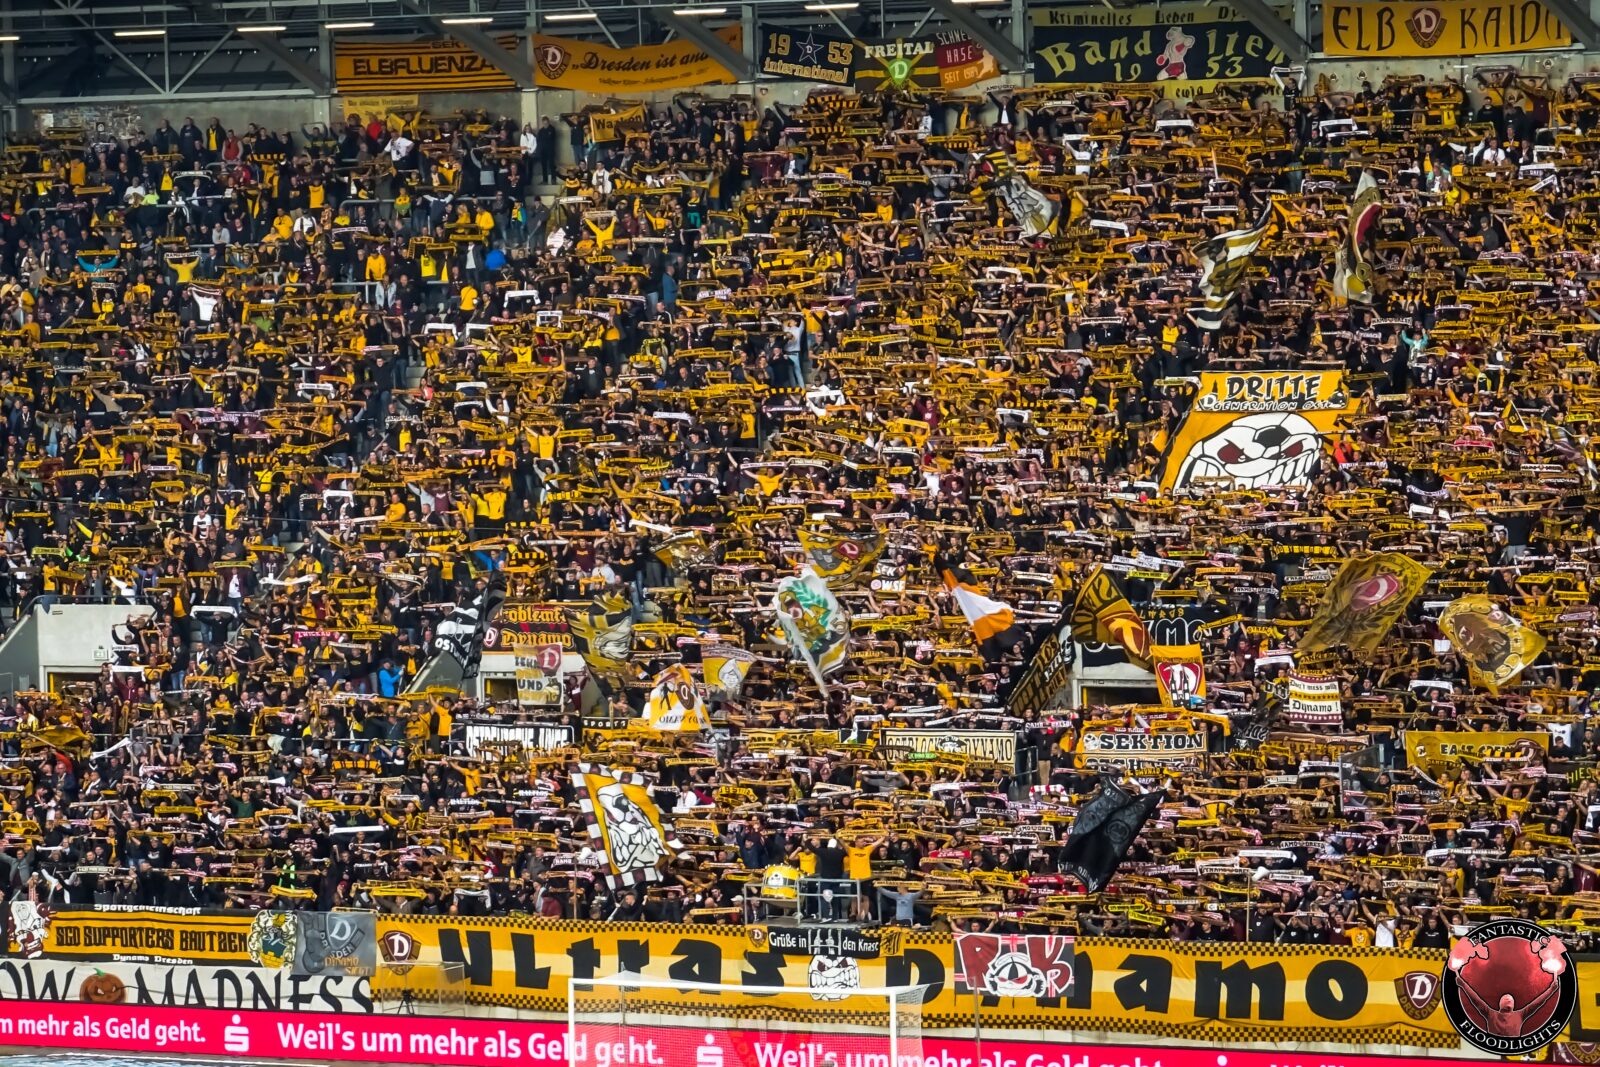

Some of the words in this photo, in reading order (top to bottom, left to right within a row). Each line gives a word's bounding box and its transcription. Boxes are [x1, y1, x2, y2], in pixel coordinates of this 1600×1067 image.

[1048, 9, 1132, 25] Kriminelles
[1332, 6, 1396, 51] ELB
[768, 33, 791, 55] 19
[827, 41, 854, 65] 53
[864, 41, 934, 59] FREITAL
[946, 45, 973, 63] HASE
[1035, 30, 1152, 78] Band
[655, 53, 678, 68] ist
[763, 57, 849, 83] international
[1113, 62, 1142, 82] 19
[1205, 53, 1243, 78] 53
[944, 70, 961, 84] SEIT
[1226, 374, 1322, 400] DRITTE
[517, 678, 543, 691] UND
[1291, 699, 1333, 713] Dynamo
[1098, 732, 1206, 751] SEKTION
[55, 925, 81, 946] SGD
[83, 926, 174, 950] SUPPORTERS
[179, 929, 248, 952] BAUTZEN
[768, 931, 797, 949] Grüße
[798, 934, 807, 948] in
[842, 937, 856, 951] den
[112, 952, 150, 963] Dynamo
[153, 955, 194, 965] Dresden
[18, 1015, 70, 1038] mehr
[73, 1015, 102, 1038] als
[106, 1018, 151, 1041] Geld
[155, 1022, 206, 1046] geht.
[277, 1021, 356, 1051] Weil's
[362, 1032, 402, 1053] um
[409, 1028, 479, 1056] mehr
[483, 1030, 522, 1058] als
[528, 1032, 589, 1062] Geld
[594, 1034, 664, 1067] geht.
[754, 1042, 844, 1067] Weil's
